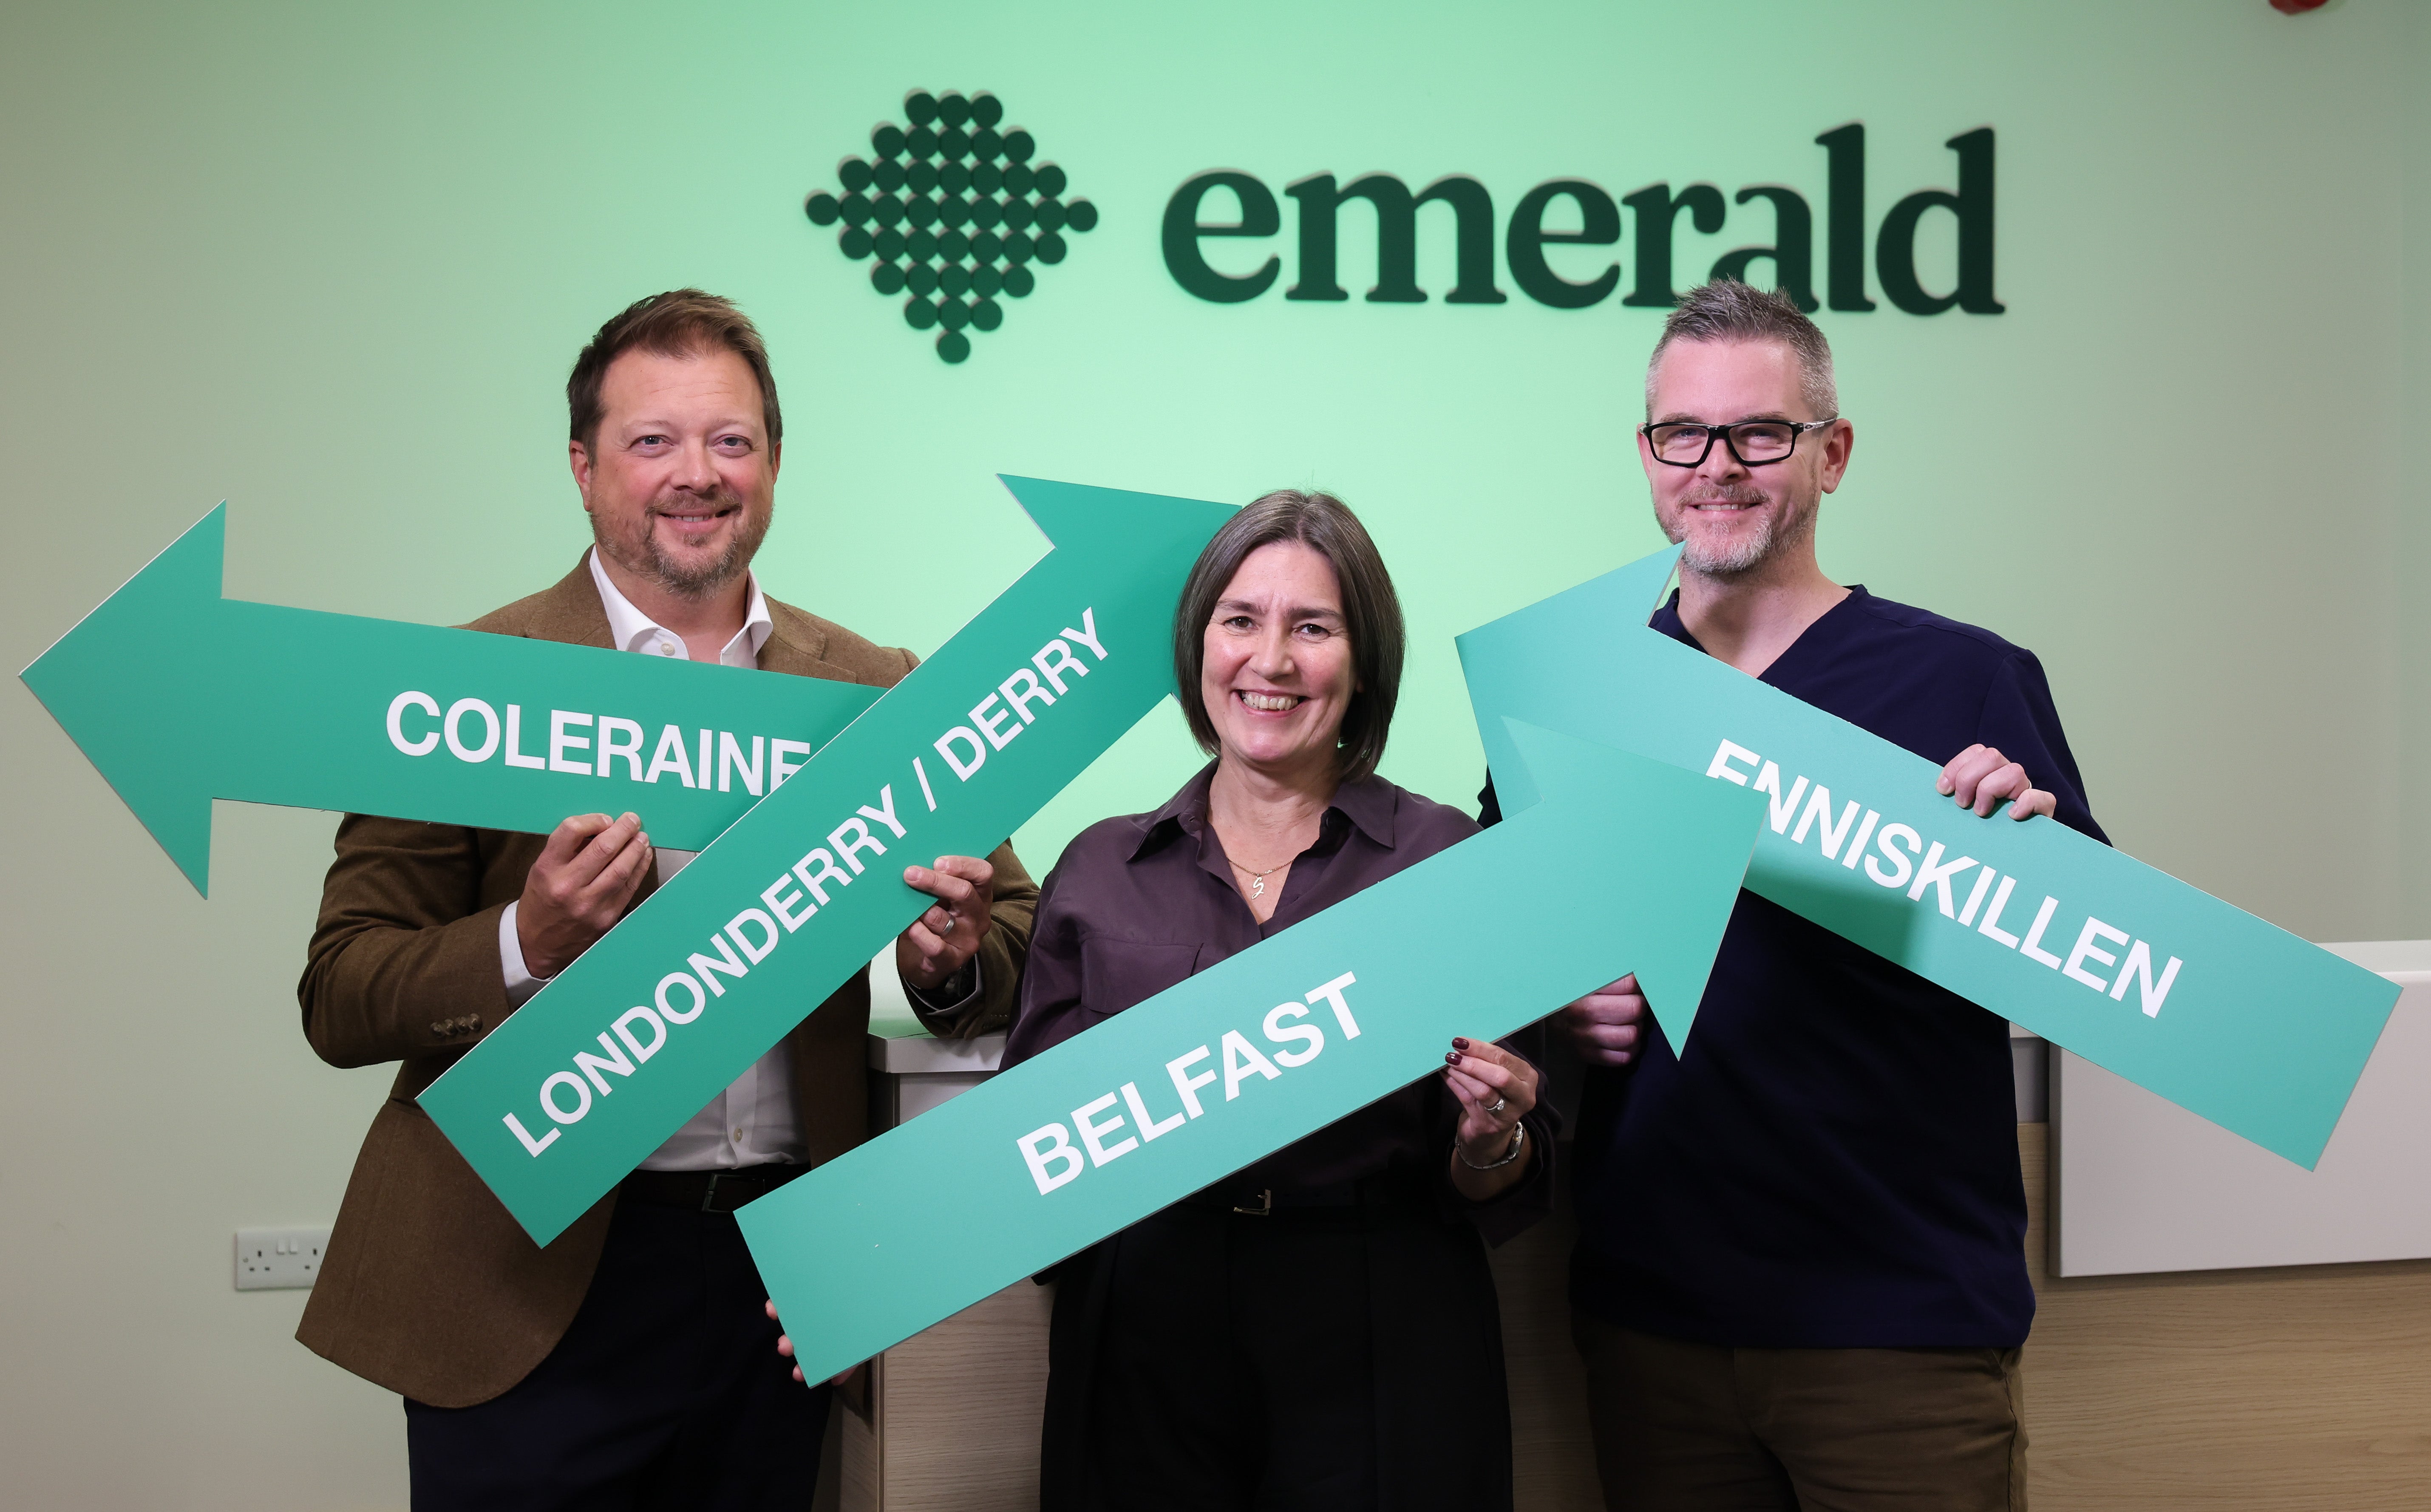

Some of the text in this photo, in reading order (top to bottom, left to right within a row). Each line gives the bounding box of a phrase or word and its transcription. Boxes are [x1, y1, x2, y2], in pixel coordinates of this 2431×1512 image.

[1162, 123, 2006, 317] emerald
[503, 607, 1108, 1158] LONDONDERRY / DERRY
[1016, 971, 1361, 1196] BELFAST
